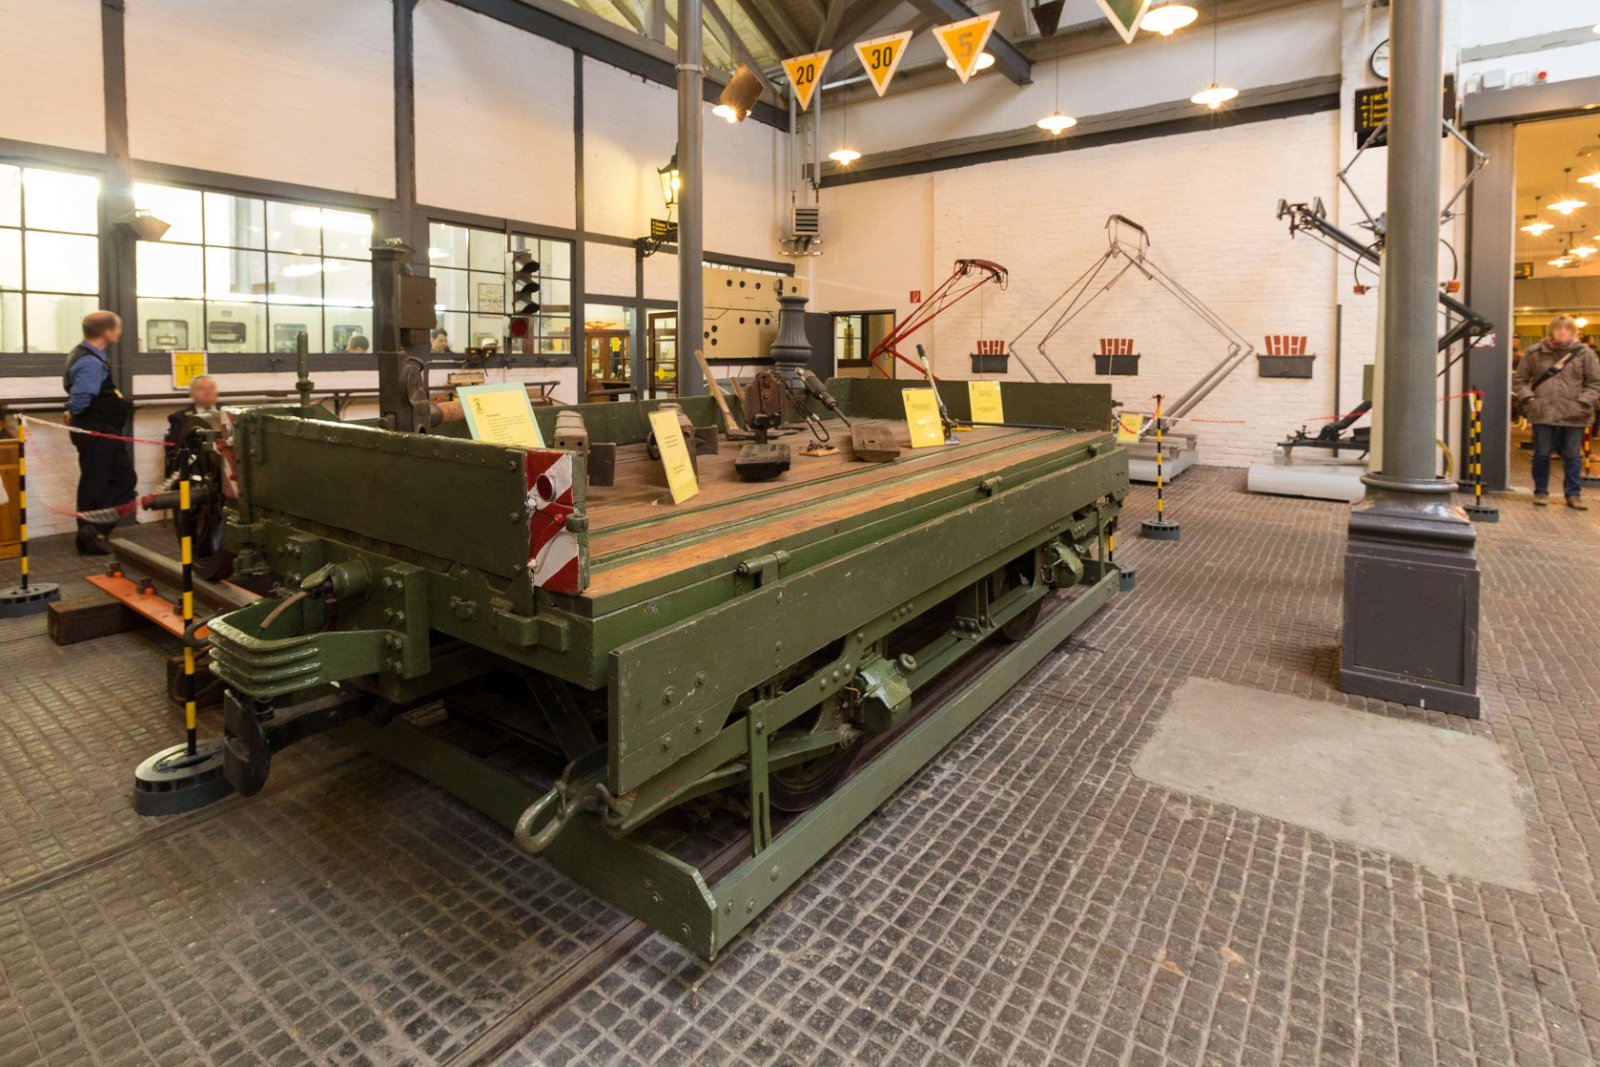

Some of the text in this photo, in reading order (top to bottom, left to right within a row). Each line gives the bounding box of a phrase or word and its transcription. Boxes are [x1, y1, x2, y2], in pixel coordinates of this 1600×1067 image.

[958, 32, 973, 59] 5
[872, 46, 893, 70] 30
[796, 64, 815, 85] 20
